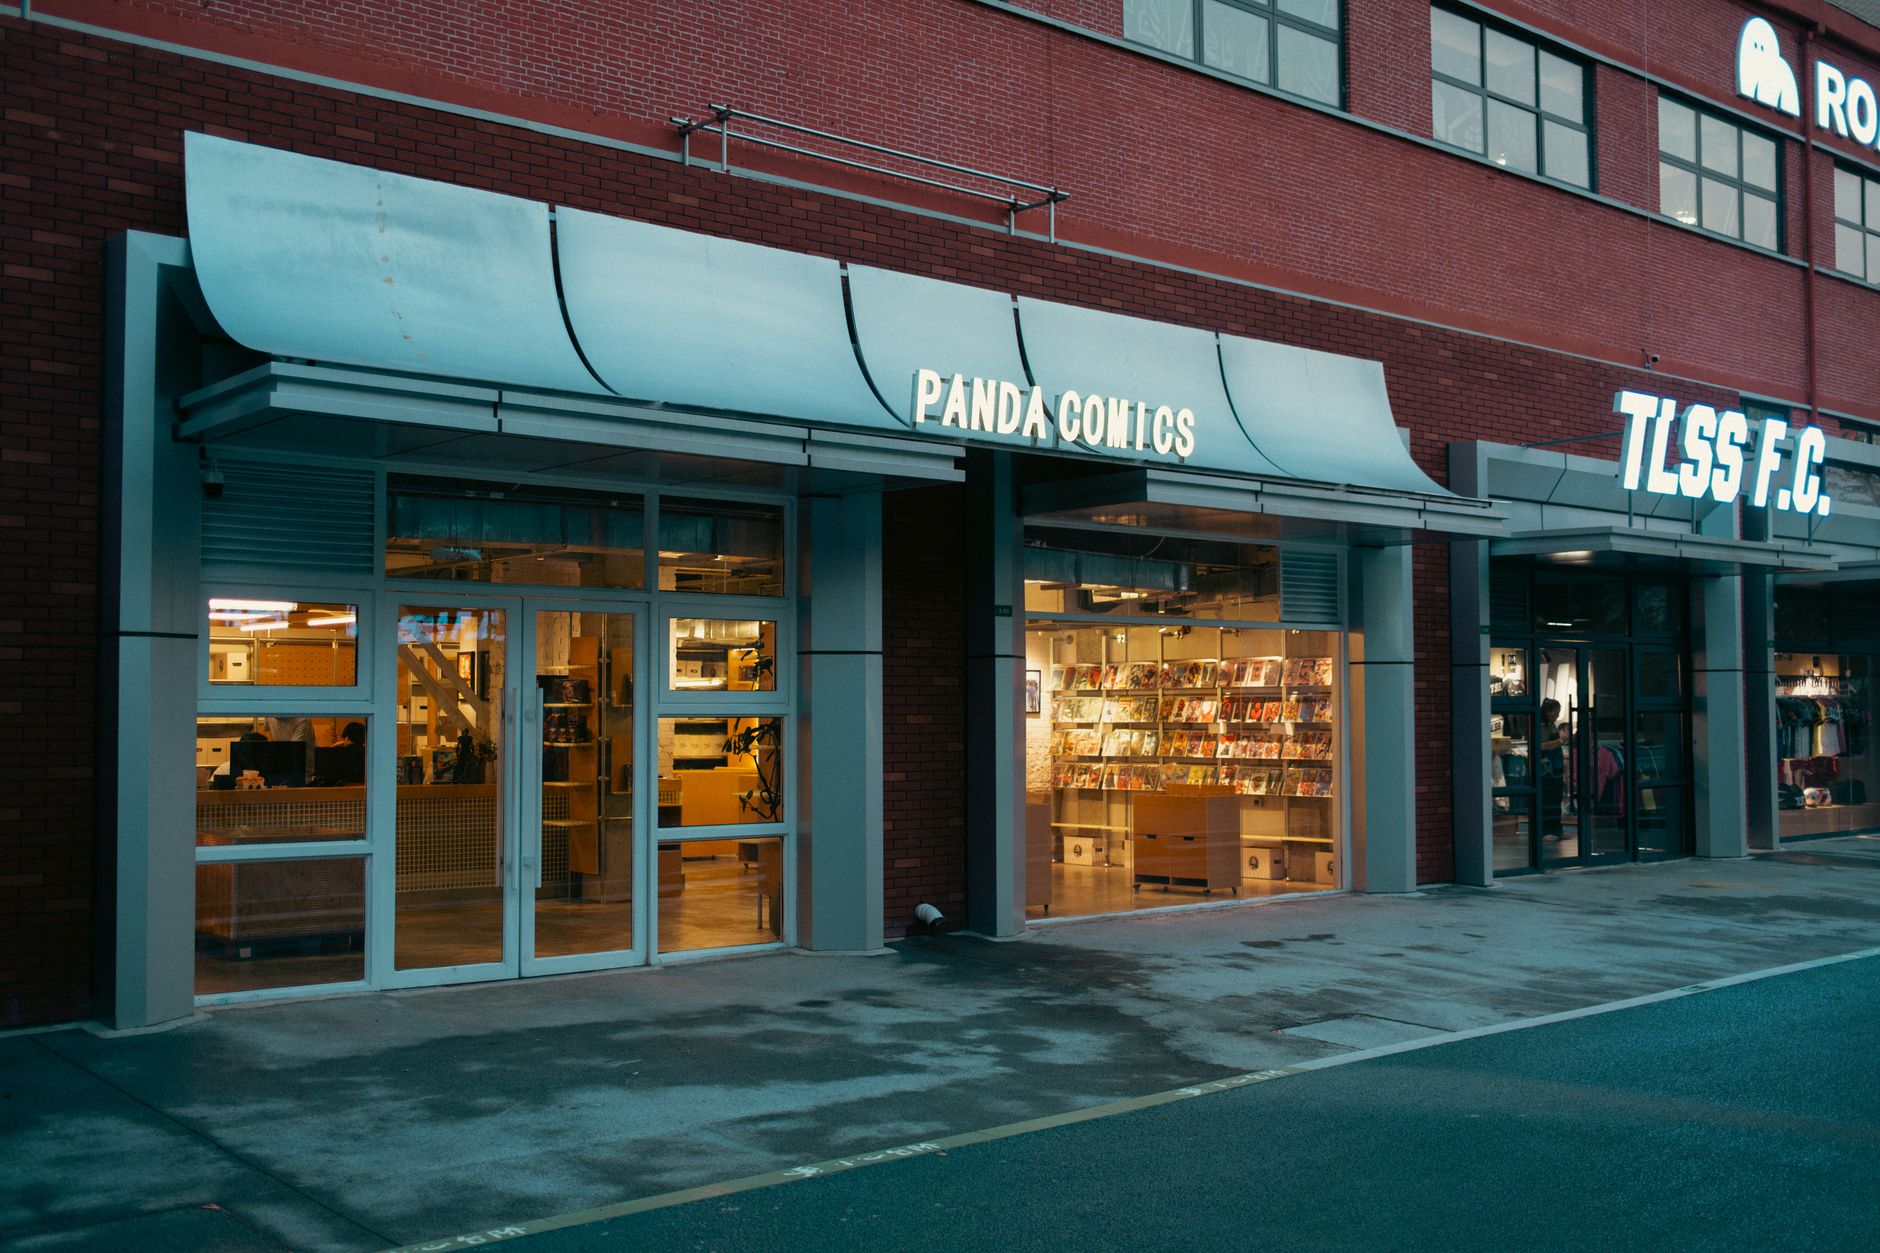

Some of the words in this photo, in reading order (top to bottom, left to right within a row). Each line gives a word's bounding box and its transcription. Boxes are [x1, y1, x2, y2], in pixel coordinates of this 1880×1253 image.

[1816, 60, 1880, 150] RO
[914, 368, 1047, 439] PANDA
[1057, 390, 1196, 458] COMICS
[1616, 390, 1748, 503] TLSS
[1753, 418, 1831, 516] F.C.
